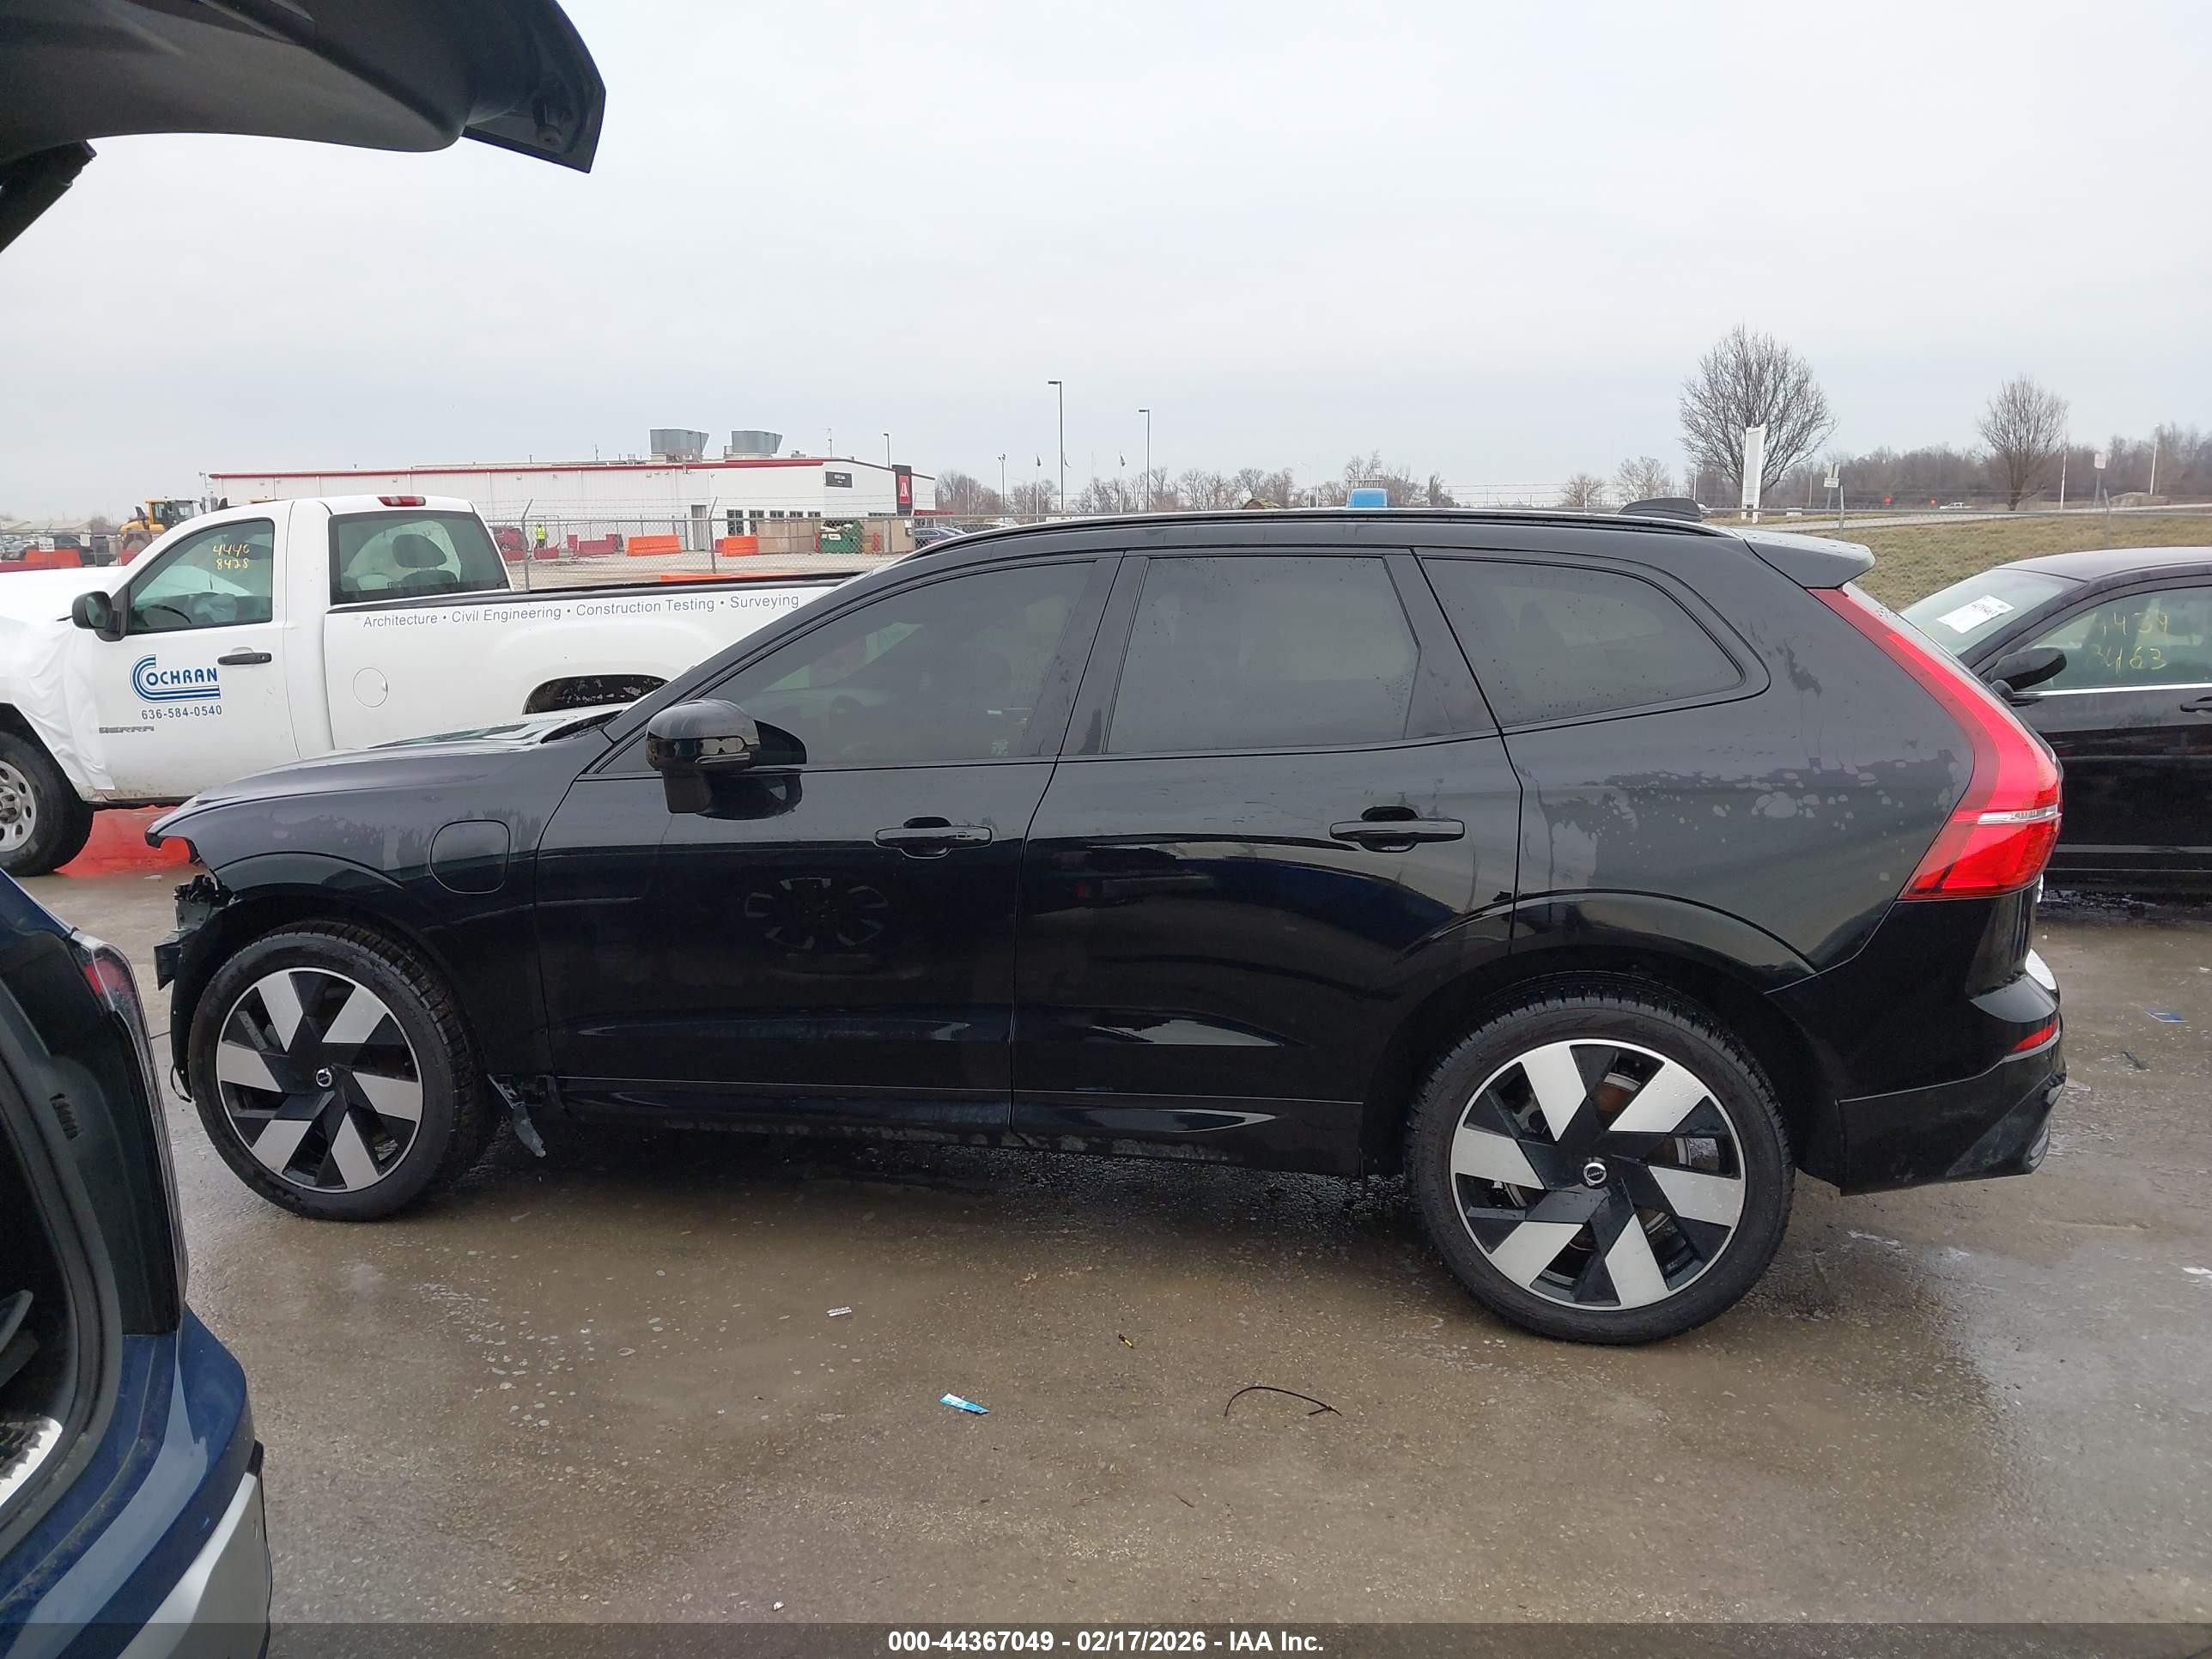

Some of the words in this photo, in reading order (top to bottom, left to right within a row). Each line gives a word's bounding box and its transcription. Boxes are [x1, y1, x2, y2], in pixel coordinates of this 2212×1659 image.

[216, 557, 249, 570] 8428
[363, 613, 438, 628] Architecture
[451, 610, 479, 623] Civil
[483, 606, 562, 623] Engineering
[576, 603, 661, 617] Construction
[665, 599, 714, 612] Testing
[730, 594, 799, 609] Surveying
[130, 654, 221, 703] COCHRAN
[141, 704, 222, 720] 636-584-0540
